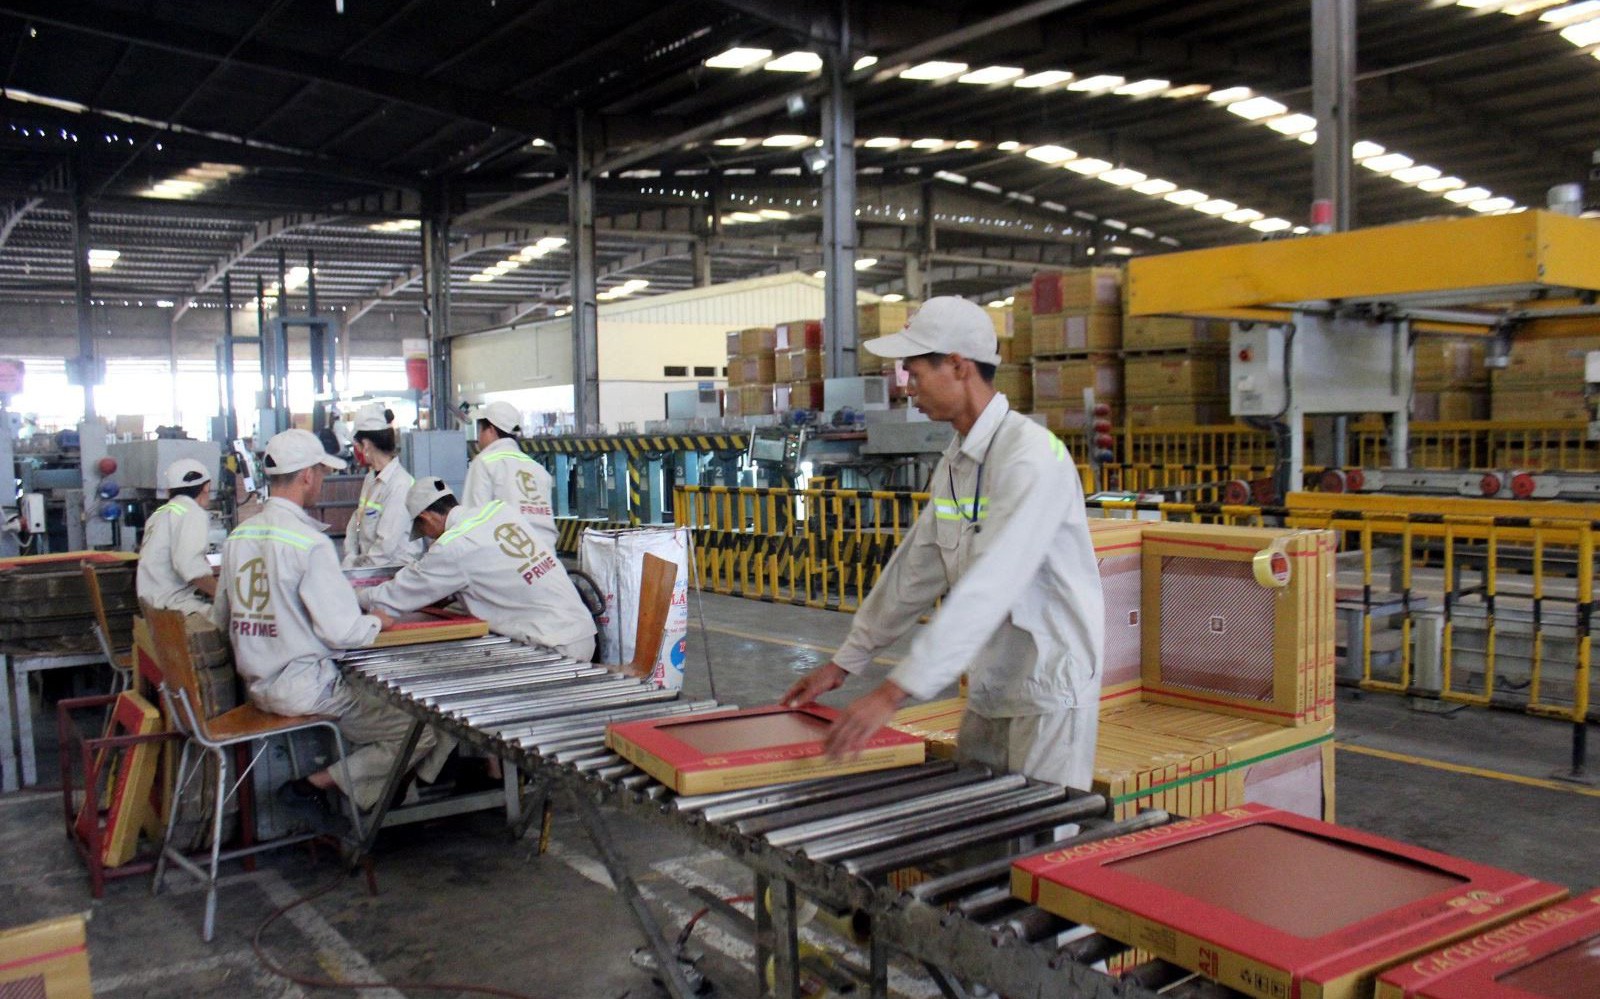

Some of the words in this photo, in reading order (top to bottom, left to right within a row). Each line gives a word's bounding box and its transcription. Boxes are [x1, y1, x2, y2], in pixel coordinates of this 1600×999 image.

[676, 466, 683, 476] 3
[715, 467, 723, 477] 2
[520, 505, 551, 515] PRIME
[522, 556, 556, 585] PRIME
[232, 621, 277, 637] PRIME
